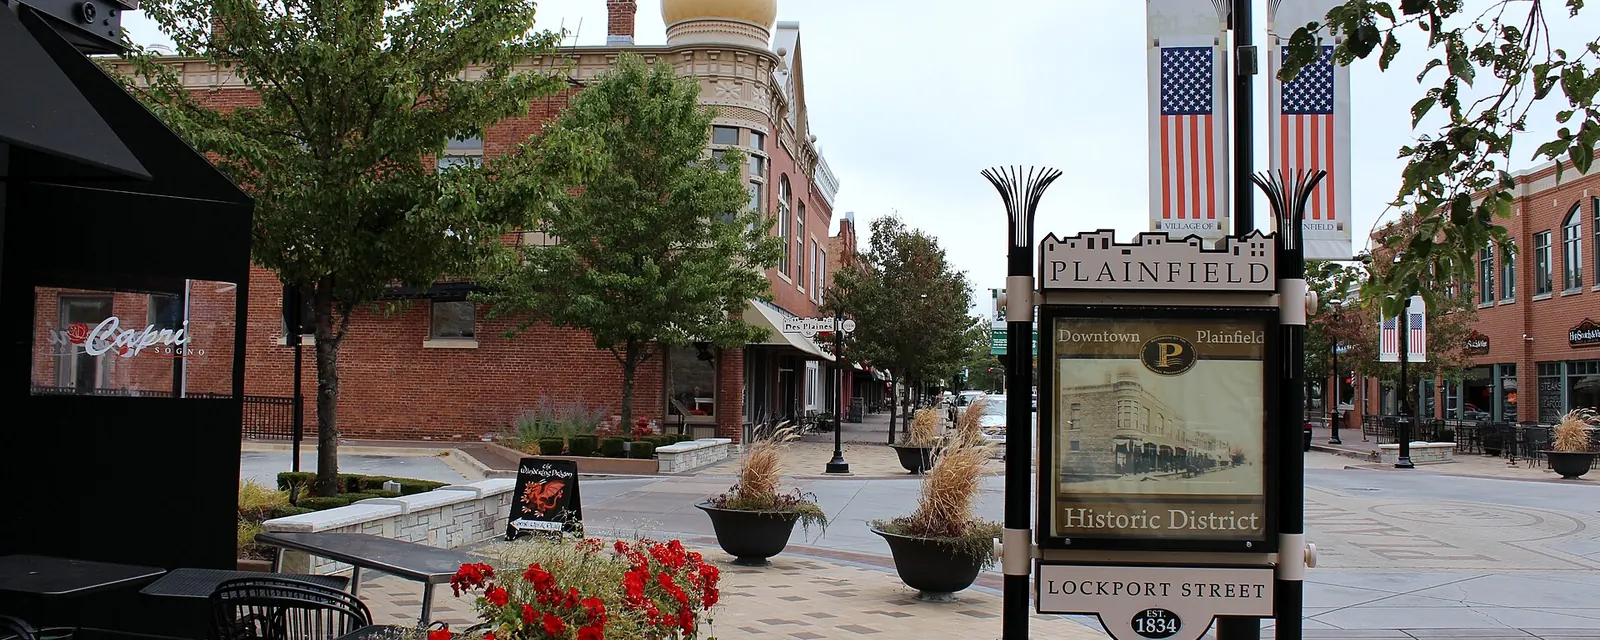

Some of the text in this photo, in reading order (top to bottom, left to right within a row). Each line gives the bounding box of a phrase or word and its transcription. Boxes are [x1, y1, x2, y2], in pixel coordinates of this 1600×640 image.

[1050, 261, 1270, 284] PLAINFIELD
[85, 316, 189, 358] Capri
[1058, 329, 1141, 343] Downtown
[1196, 330, 1264, 344] Plainfield
[154, 346, 205, 356] SOGNO
[1064, 507, 1260, 531] Historic District
[1048, 580, 1265, 598] LOCKPORT STREET
[1146, 610, 1166, 618] EST.
[1135, 617, 1177, 633] 1834
